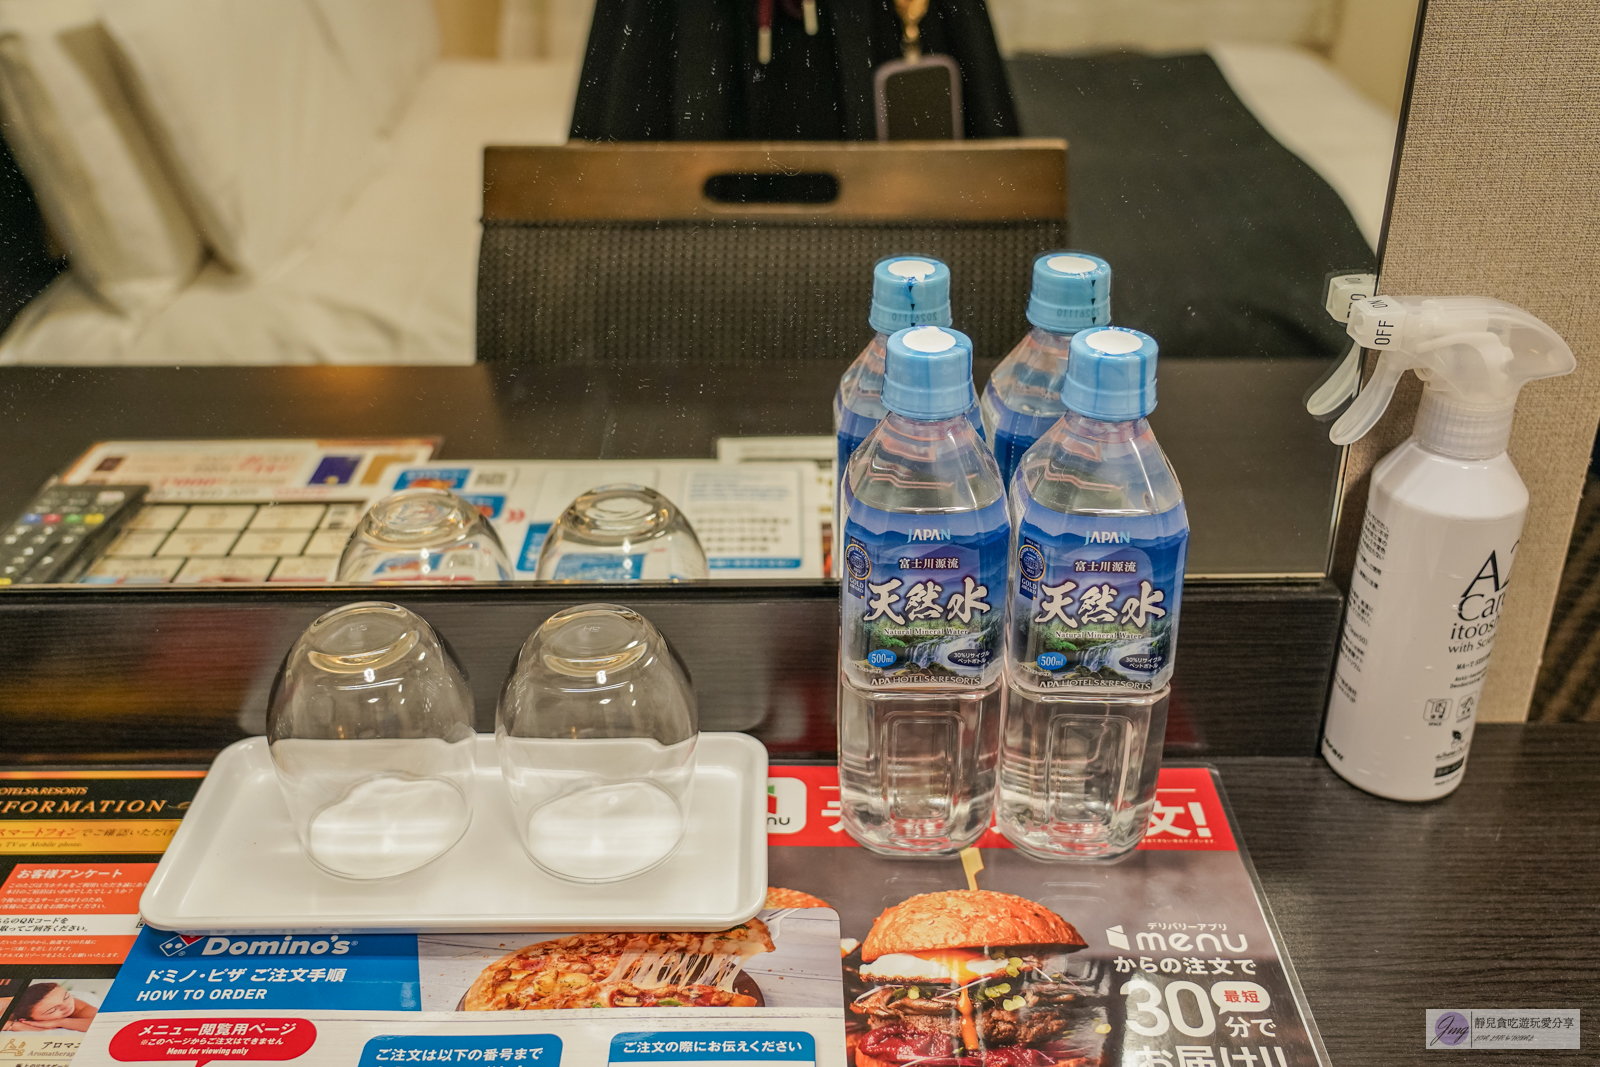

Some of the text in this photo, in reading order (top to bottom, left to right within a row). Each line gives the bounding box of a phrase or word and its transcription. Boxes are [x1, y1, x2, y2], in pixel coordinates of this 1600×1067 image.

[1374, 320, 1394, 345] OFF
[907, 529, 951, 543] JAPAN
[1084, 531, 1130, 545] JAPAN
[899, 557, 959, 570] 富士川源流
[1074, 560, 1136, 573] 富士川源流
[849, 577, 864, 588] GOLD
[1021, 578, 1037, 590] GOLD
[863, 577, 991, 625] 天然水
[1034, 581, 1166, 629] 天然水
[1448, 641, 1474, 653] with
[871, 653, 893, 663] 500ml
[1041, 656, 1063, 666] 500ml
[871, 675, 981, 686] APA HOTELS&RESORTS
[0, 800, 167, 814] FORMATION
[17, 869, 122, 879] お客様アンケート
[1147, 922, 1227, 931] デリバリーアプリ
[201, 934, 351, 956] Domino's
[1136, 932, 1248, 952] menu
[1113, 956, 1257, 975] からの注文で
[145, 968, 348, 984] ドミノ・ピザ ご注文手順
[136, 989, 267, 1002] HOW TO ORDER
[1224, 990, 1260, 1003] 最短
[1119, 980, 1216, 1037] 30
[138, 1023, 297, 1036] メニュー閲覧用ページ
[1224, 1016, 1277, 1038] 分で
[166, 1047, 249, 1056] Menu for viewing only
[623, 1040, 802, 1053] ご注文の際にお伝えください
[375, 1047, 543, 1061] ご注文は以下の番号まで
